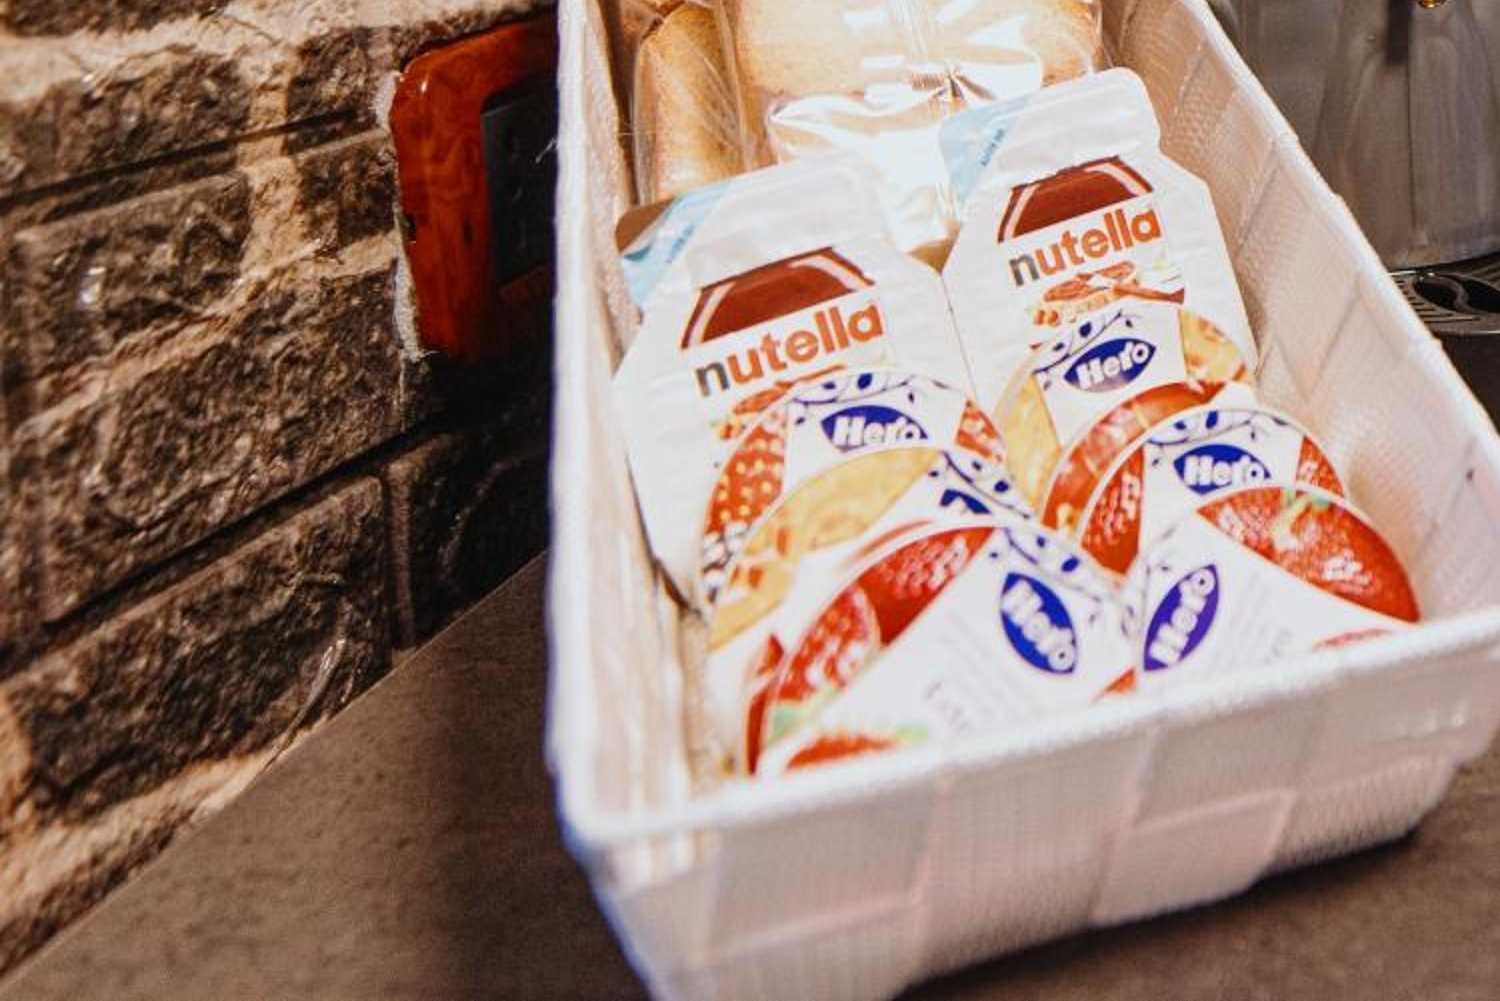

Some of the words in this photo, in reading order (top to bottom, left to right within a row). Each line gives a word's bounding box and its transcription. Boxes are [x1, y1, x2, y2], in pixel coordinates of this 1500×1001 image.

[1008, 208, 1162, 287] nutella
[695, 304, 884, 397] nutella
[1076, 341, 1150, 390] Hero
[832, 414, 922, 447] Hero
[1183, 454, 1266, 487] Hero
[1001, 578, 1075, 672] Hero
[1151, 567, 1216, 667] Hero
